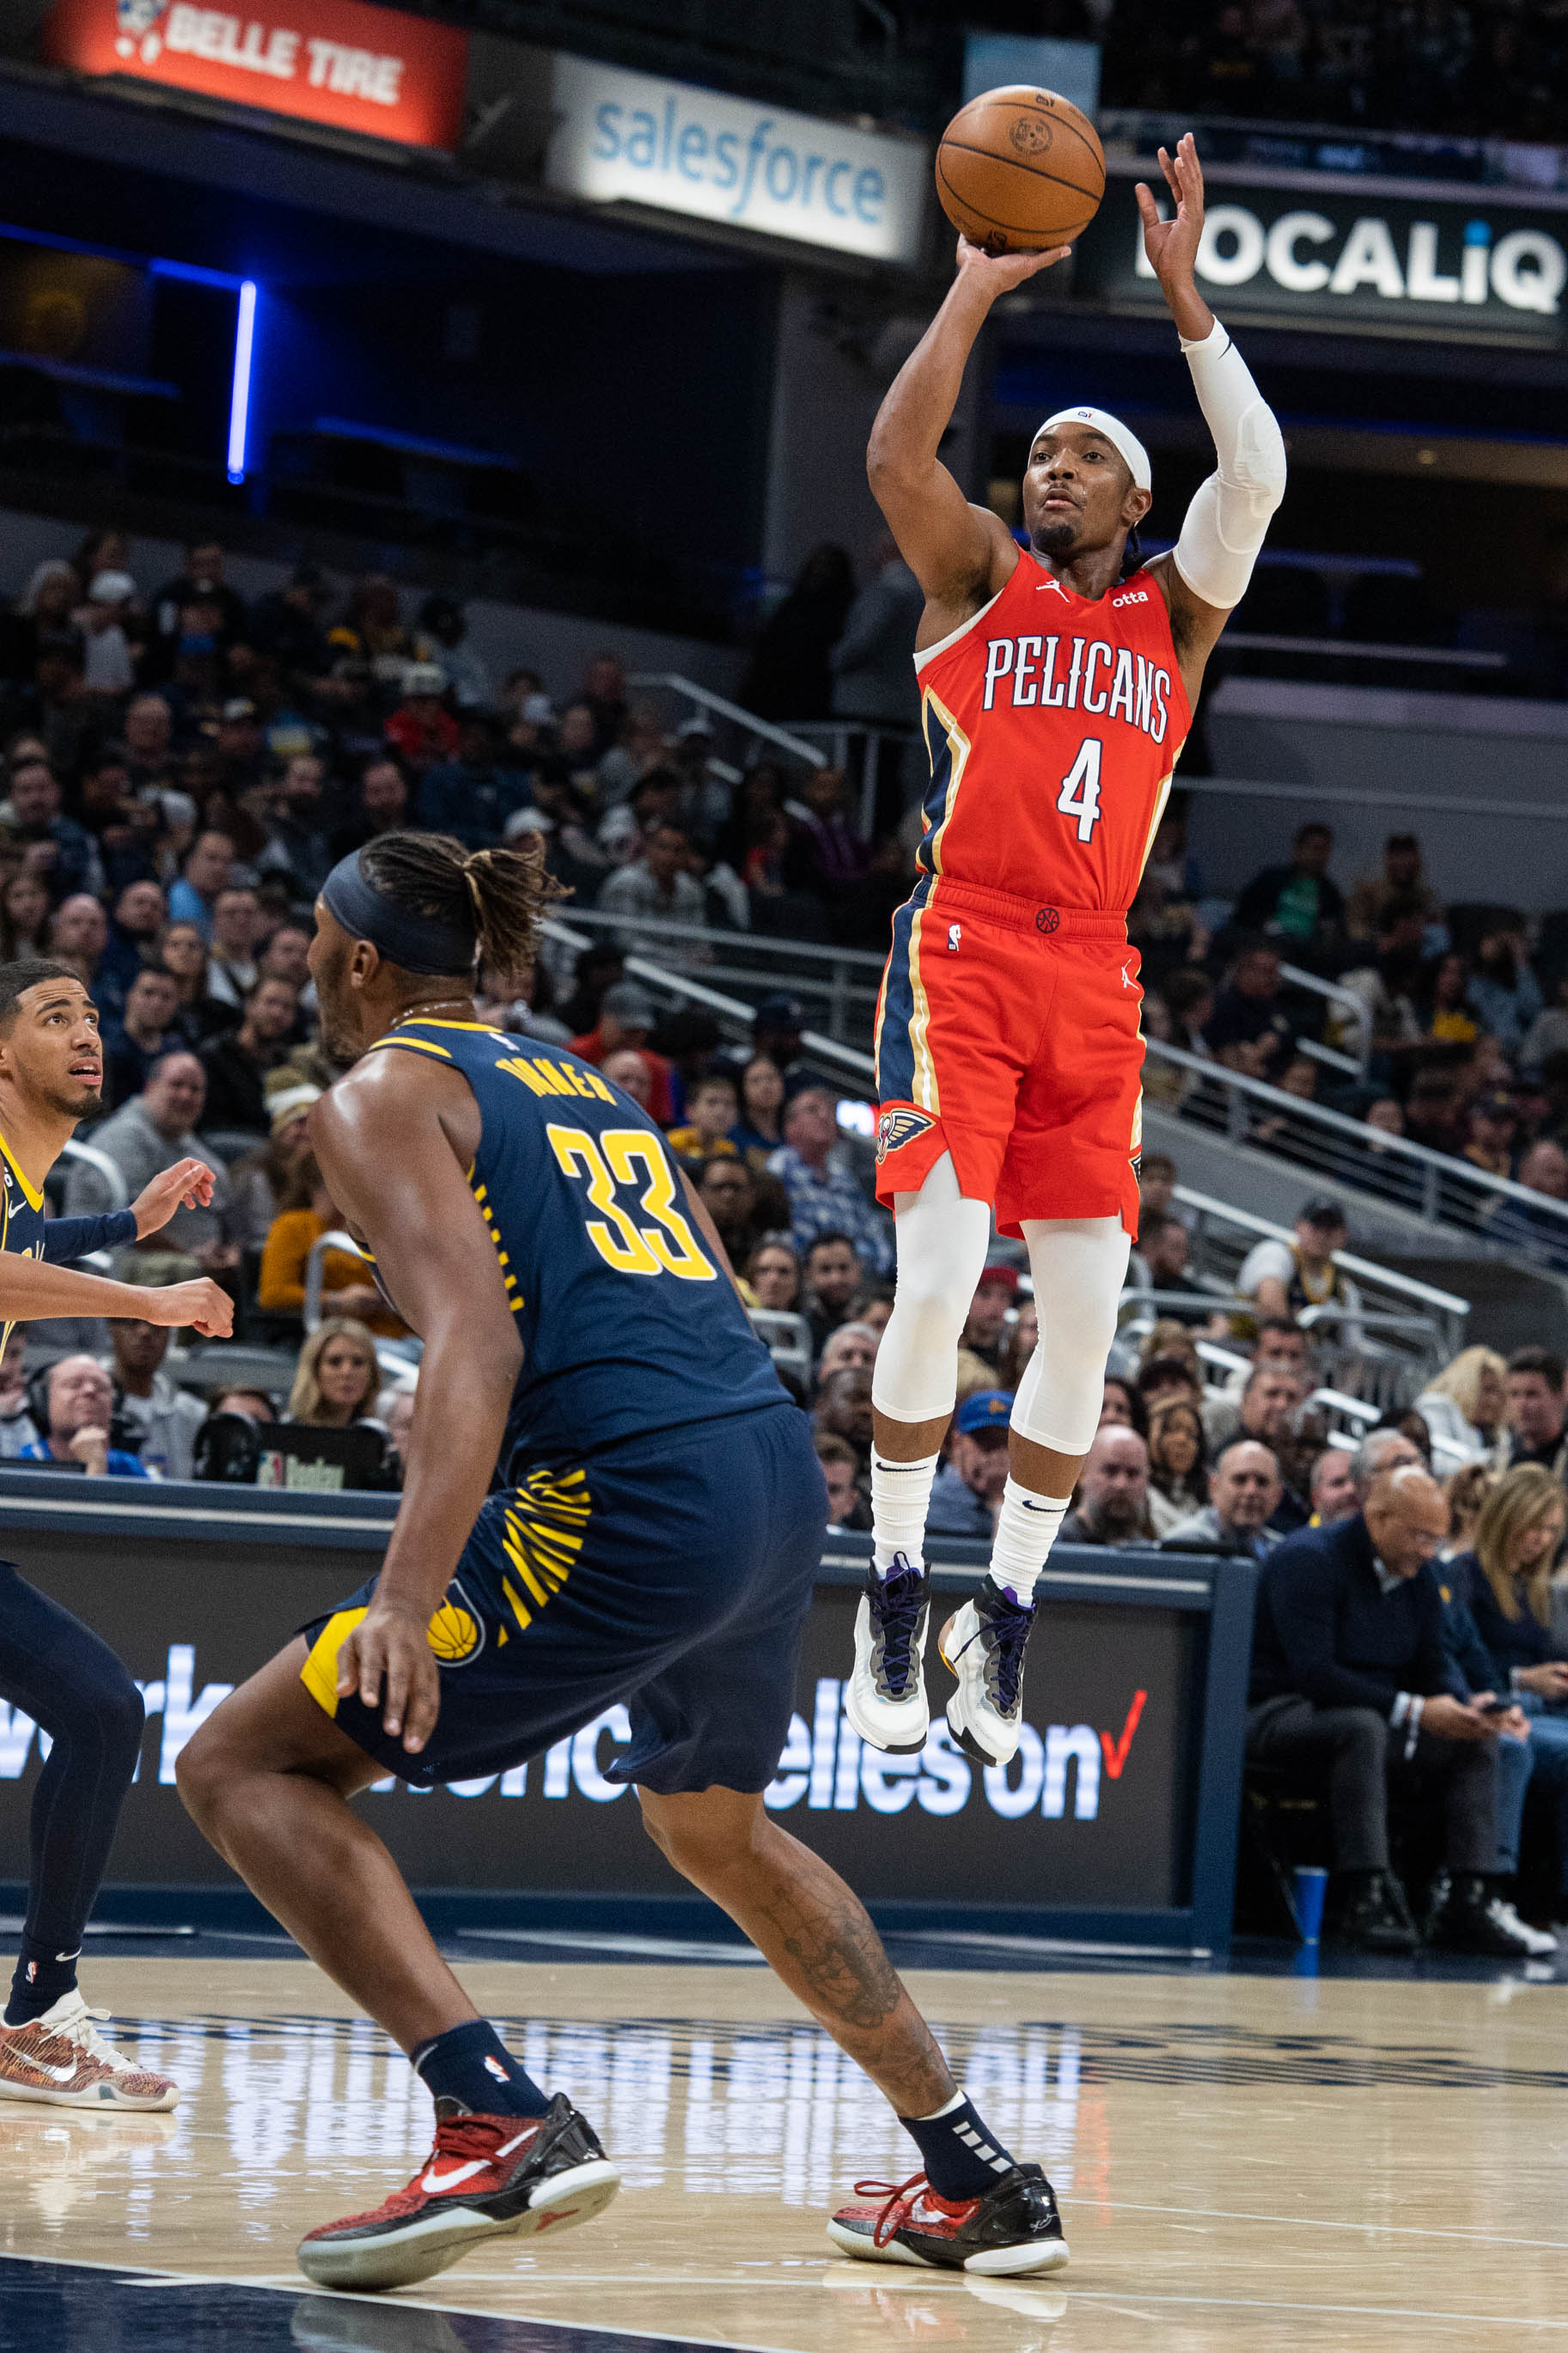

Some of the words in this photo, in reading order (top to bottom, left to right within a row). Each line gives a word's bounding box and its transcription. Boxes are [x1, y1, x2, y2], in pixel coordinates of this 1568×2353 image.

[165, 3, 301, 79] BELLE
[307, 39, 404, 106] TIRE
[590, 95, 887, 225] salesforce
[1112, 590, 1149, 608] otta
[981, 635, 1172, 744] PELICANS
[1056, 736, 1103, 844] 4
[545, 1121, 718, 1281] 33
[983, 1722, 1102, 1821] on
